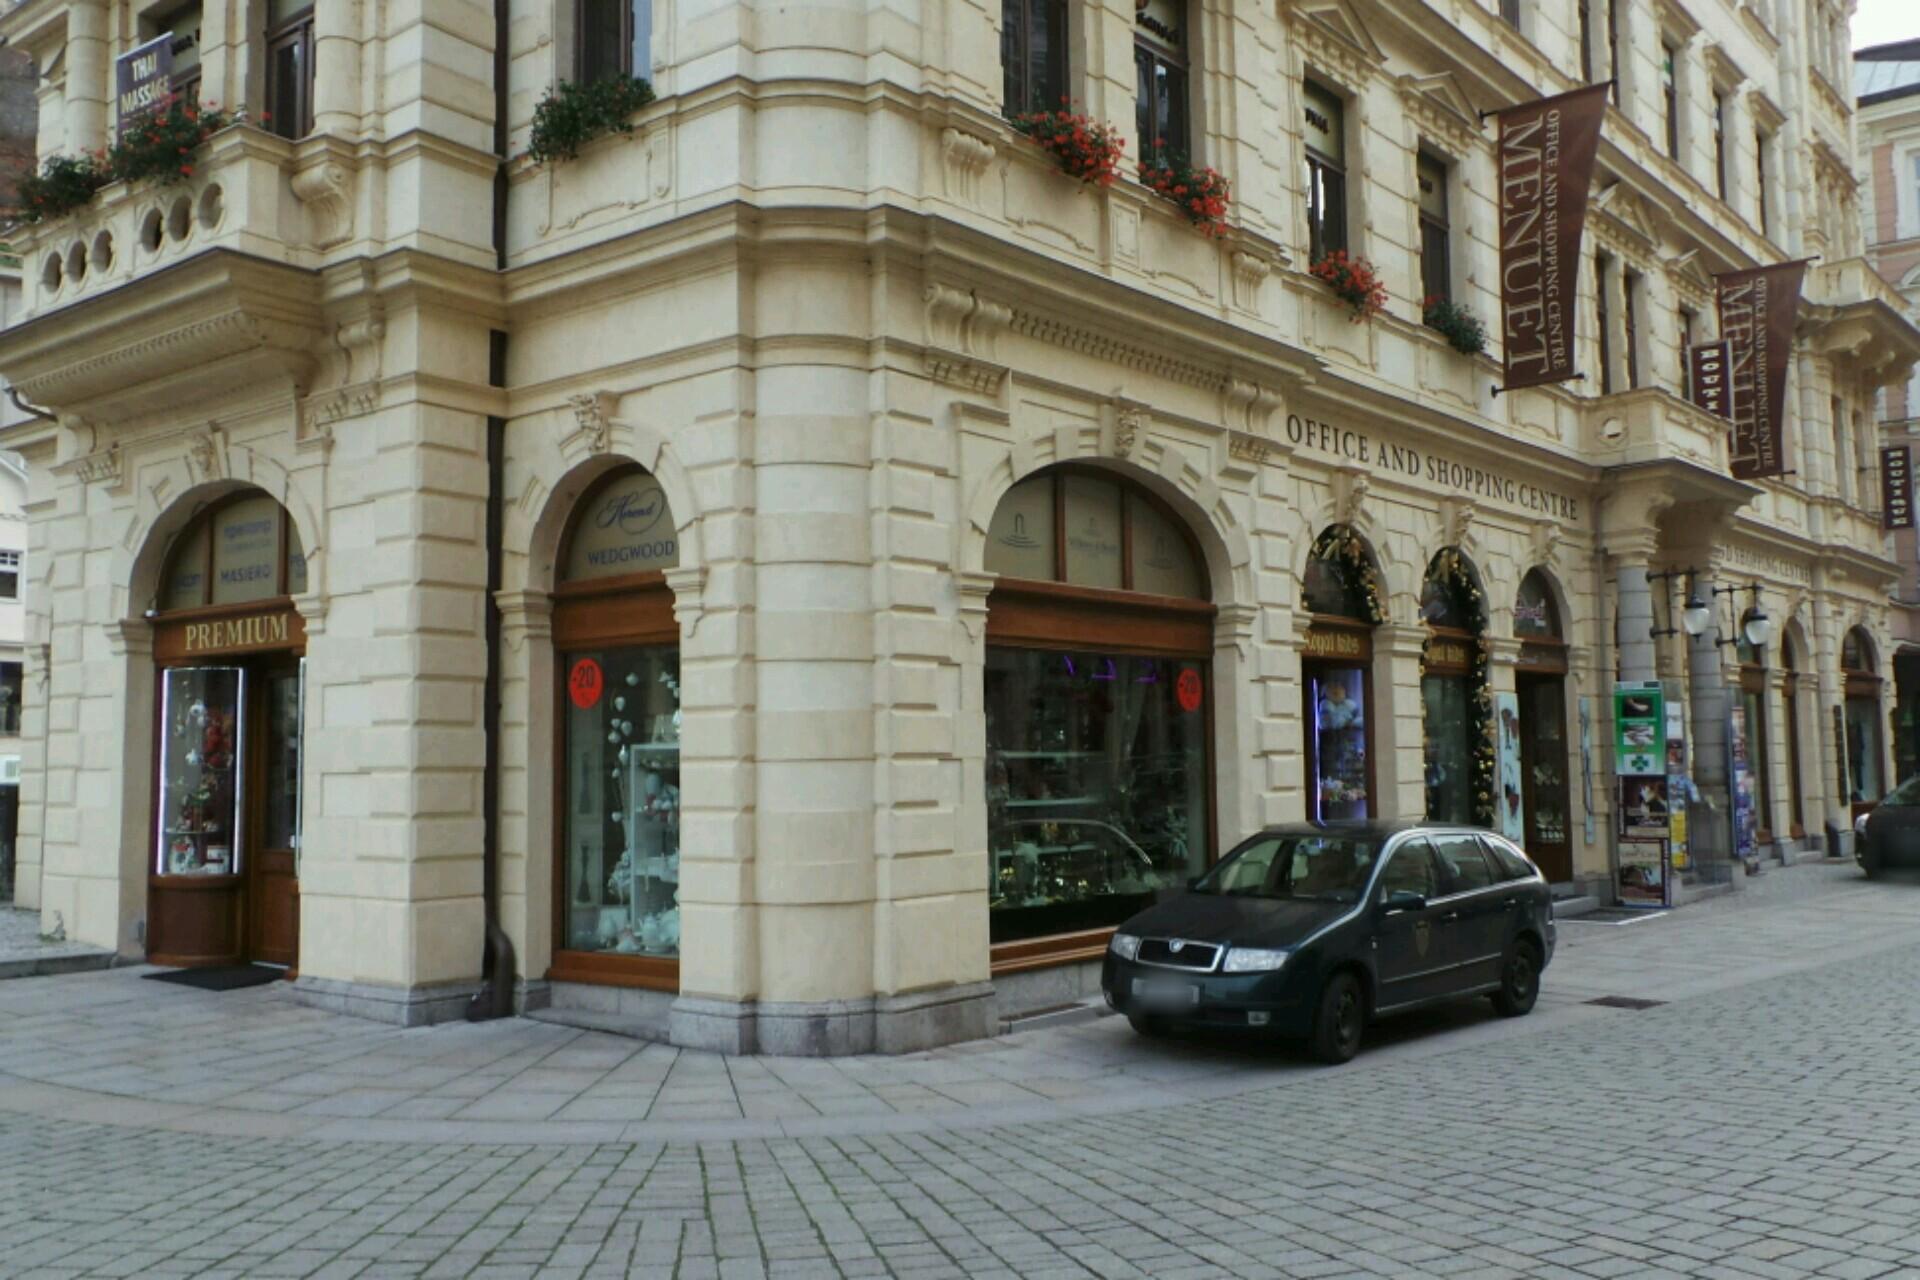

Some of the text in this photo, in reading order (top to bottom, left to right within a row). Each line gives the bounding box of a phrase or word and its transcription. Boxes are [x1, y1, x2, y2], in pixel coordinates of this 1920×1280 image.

[132, 52, 157, 82] THAI
[121, 75, 169, 113] MASSAGE
[1503, 113, 1549, 374] MENUET
[1544, 109, 1567, 370] OFFICE AND SHOPPING CENTRE
[1287, 414, 1577, 520] OFFICE AND SHOPPING CENTRE
[588, 541, 675, 567] WEDGWOOD
[220, 563, 272, 586] MASIERO
[185, 614, 289, 651] PREMIUM
